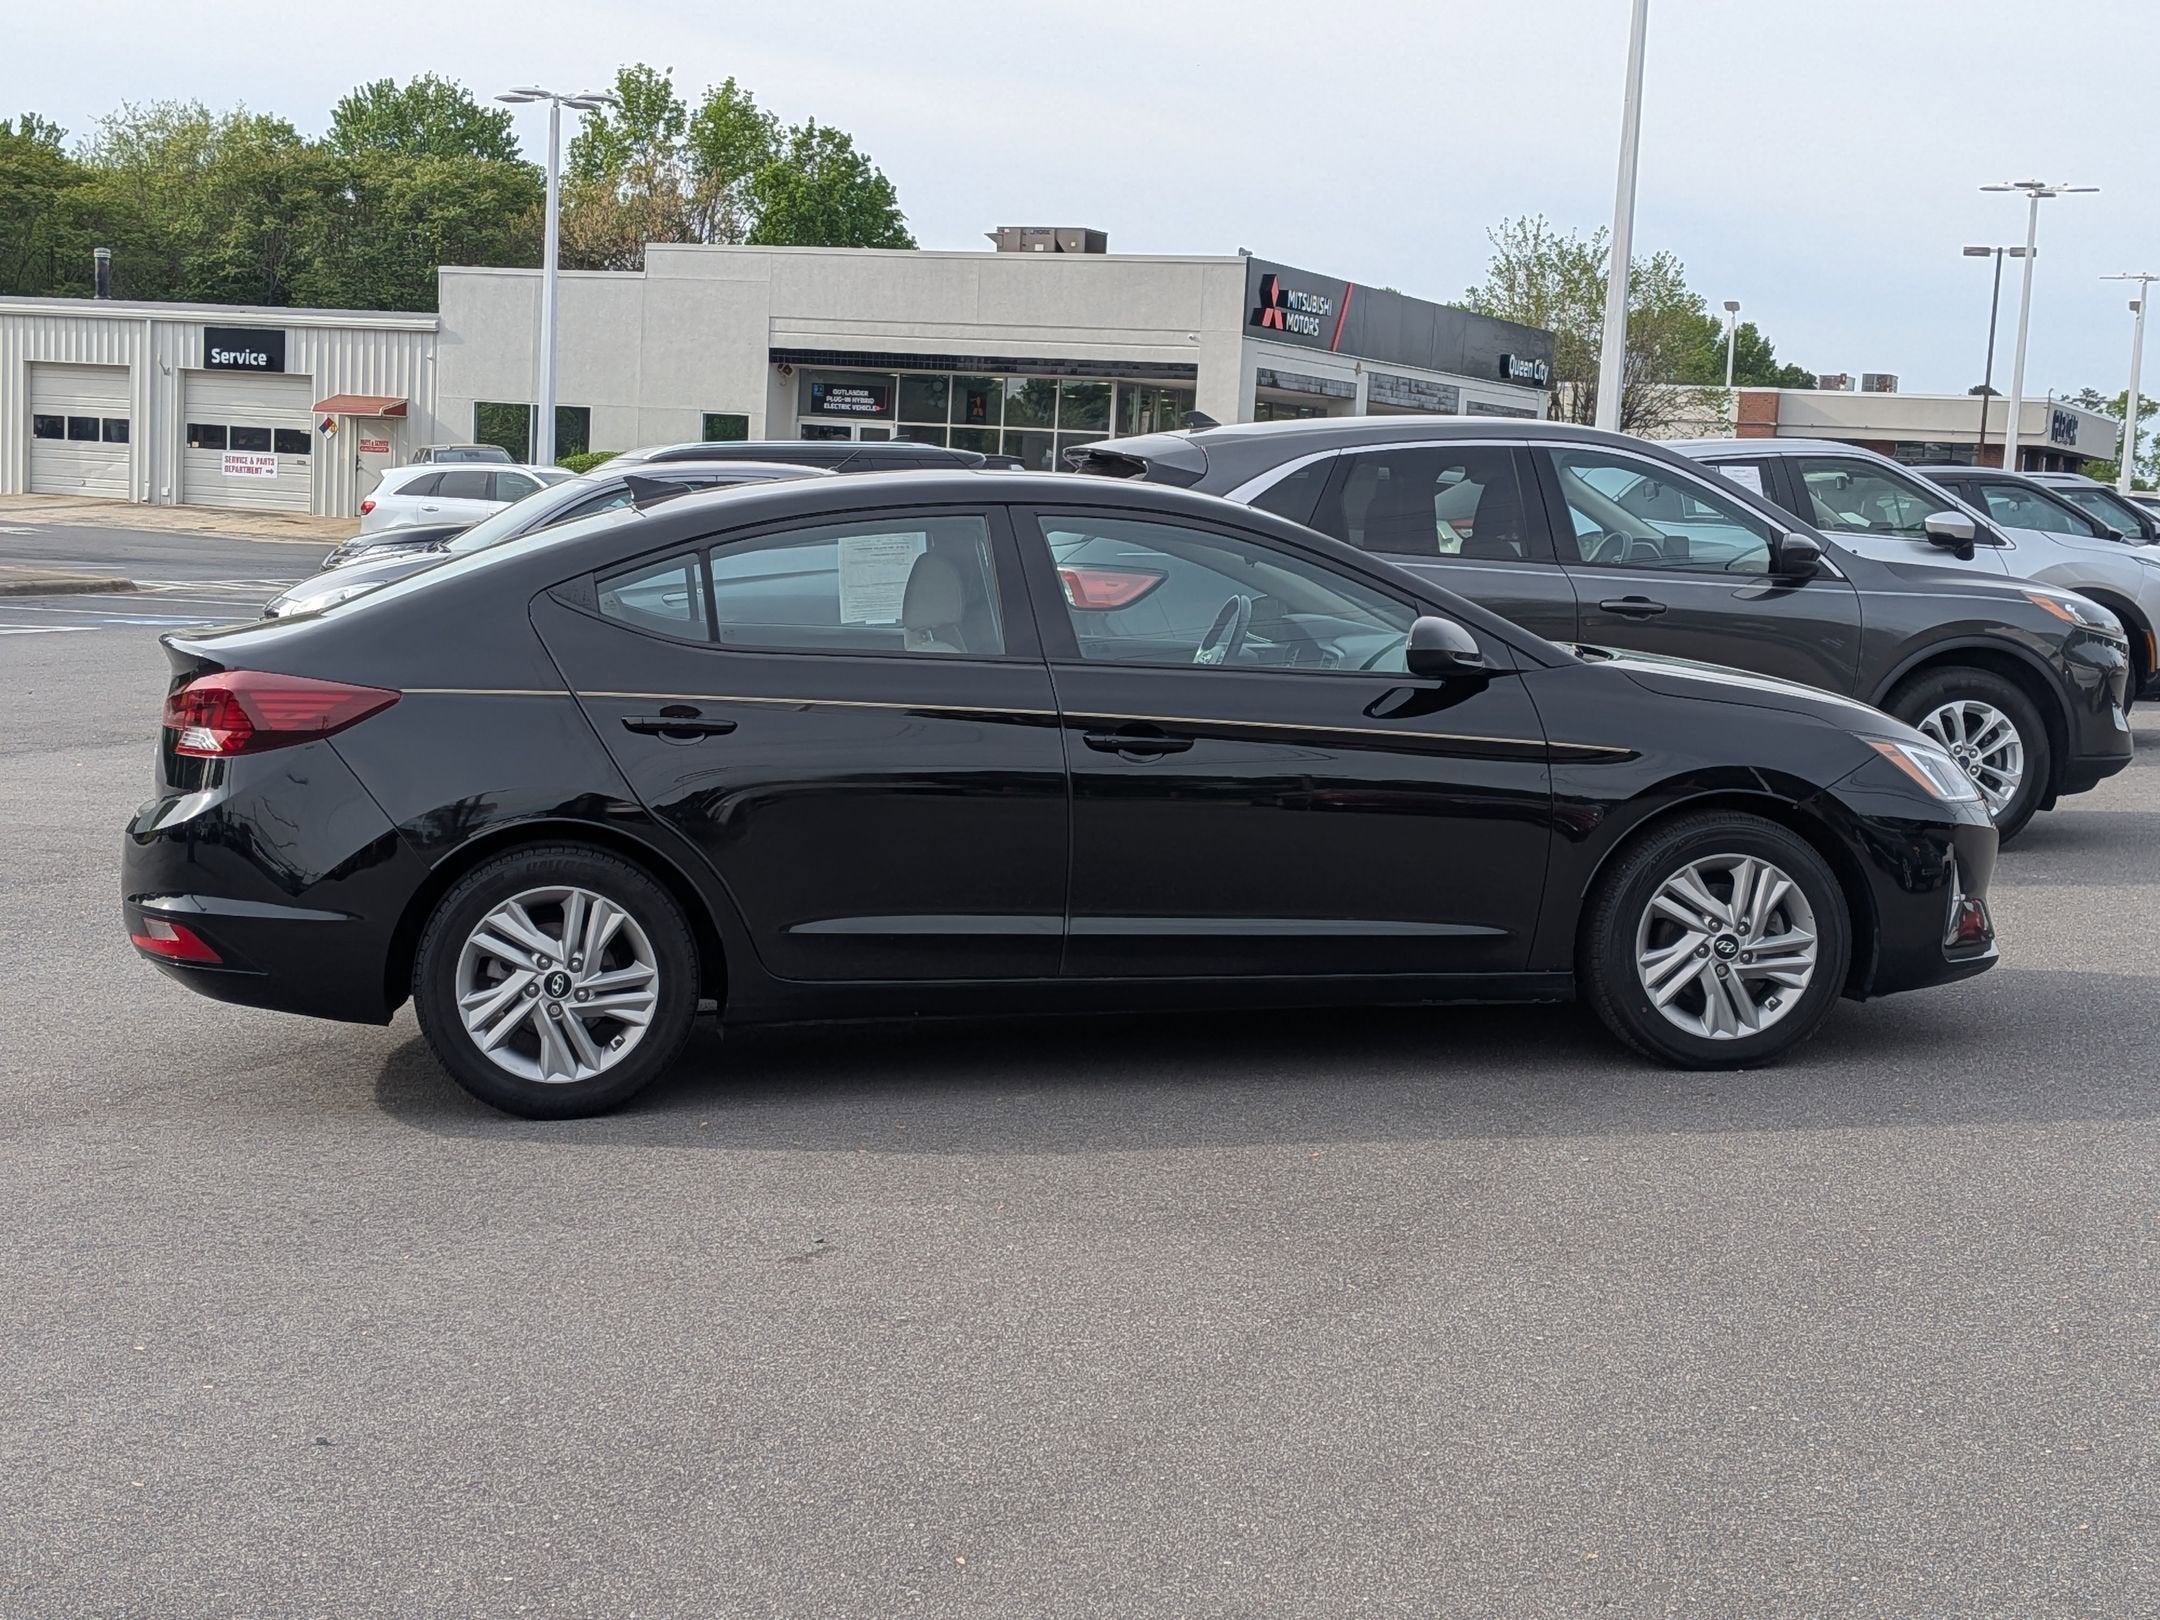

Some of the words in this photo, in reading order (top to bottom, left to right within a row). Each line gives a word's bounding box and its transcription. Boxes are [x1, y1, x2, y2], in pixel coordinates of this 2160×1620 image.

[1287, 289, 1332, 316] MITSUBISHI
[1286, 312, 1319, 336] MOTORS
[211, 348, 267, 366] Service
[1509, 354, 1533, 379] Queen
[1534, 359, 1549, 385] City
[832, 388, 869, 397] OUTLANDER
[823, 402, 851, 411] ELECTRIC
[852, 397, 875, 405] HYBRID
[224, 455, 248, 465] SERVICE
[249, 456, 255, 465] &
[256, 457, 275, 466] PARTS
[224, 465, 263, 475] DEPARTMENT
